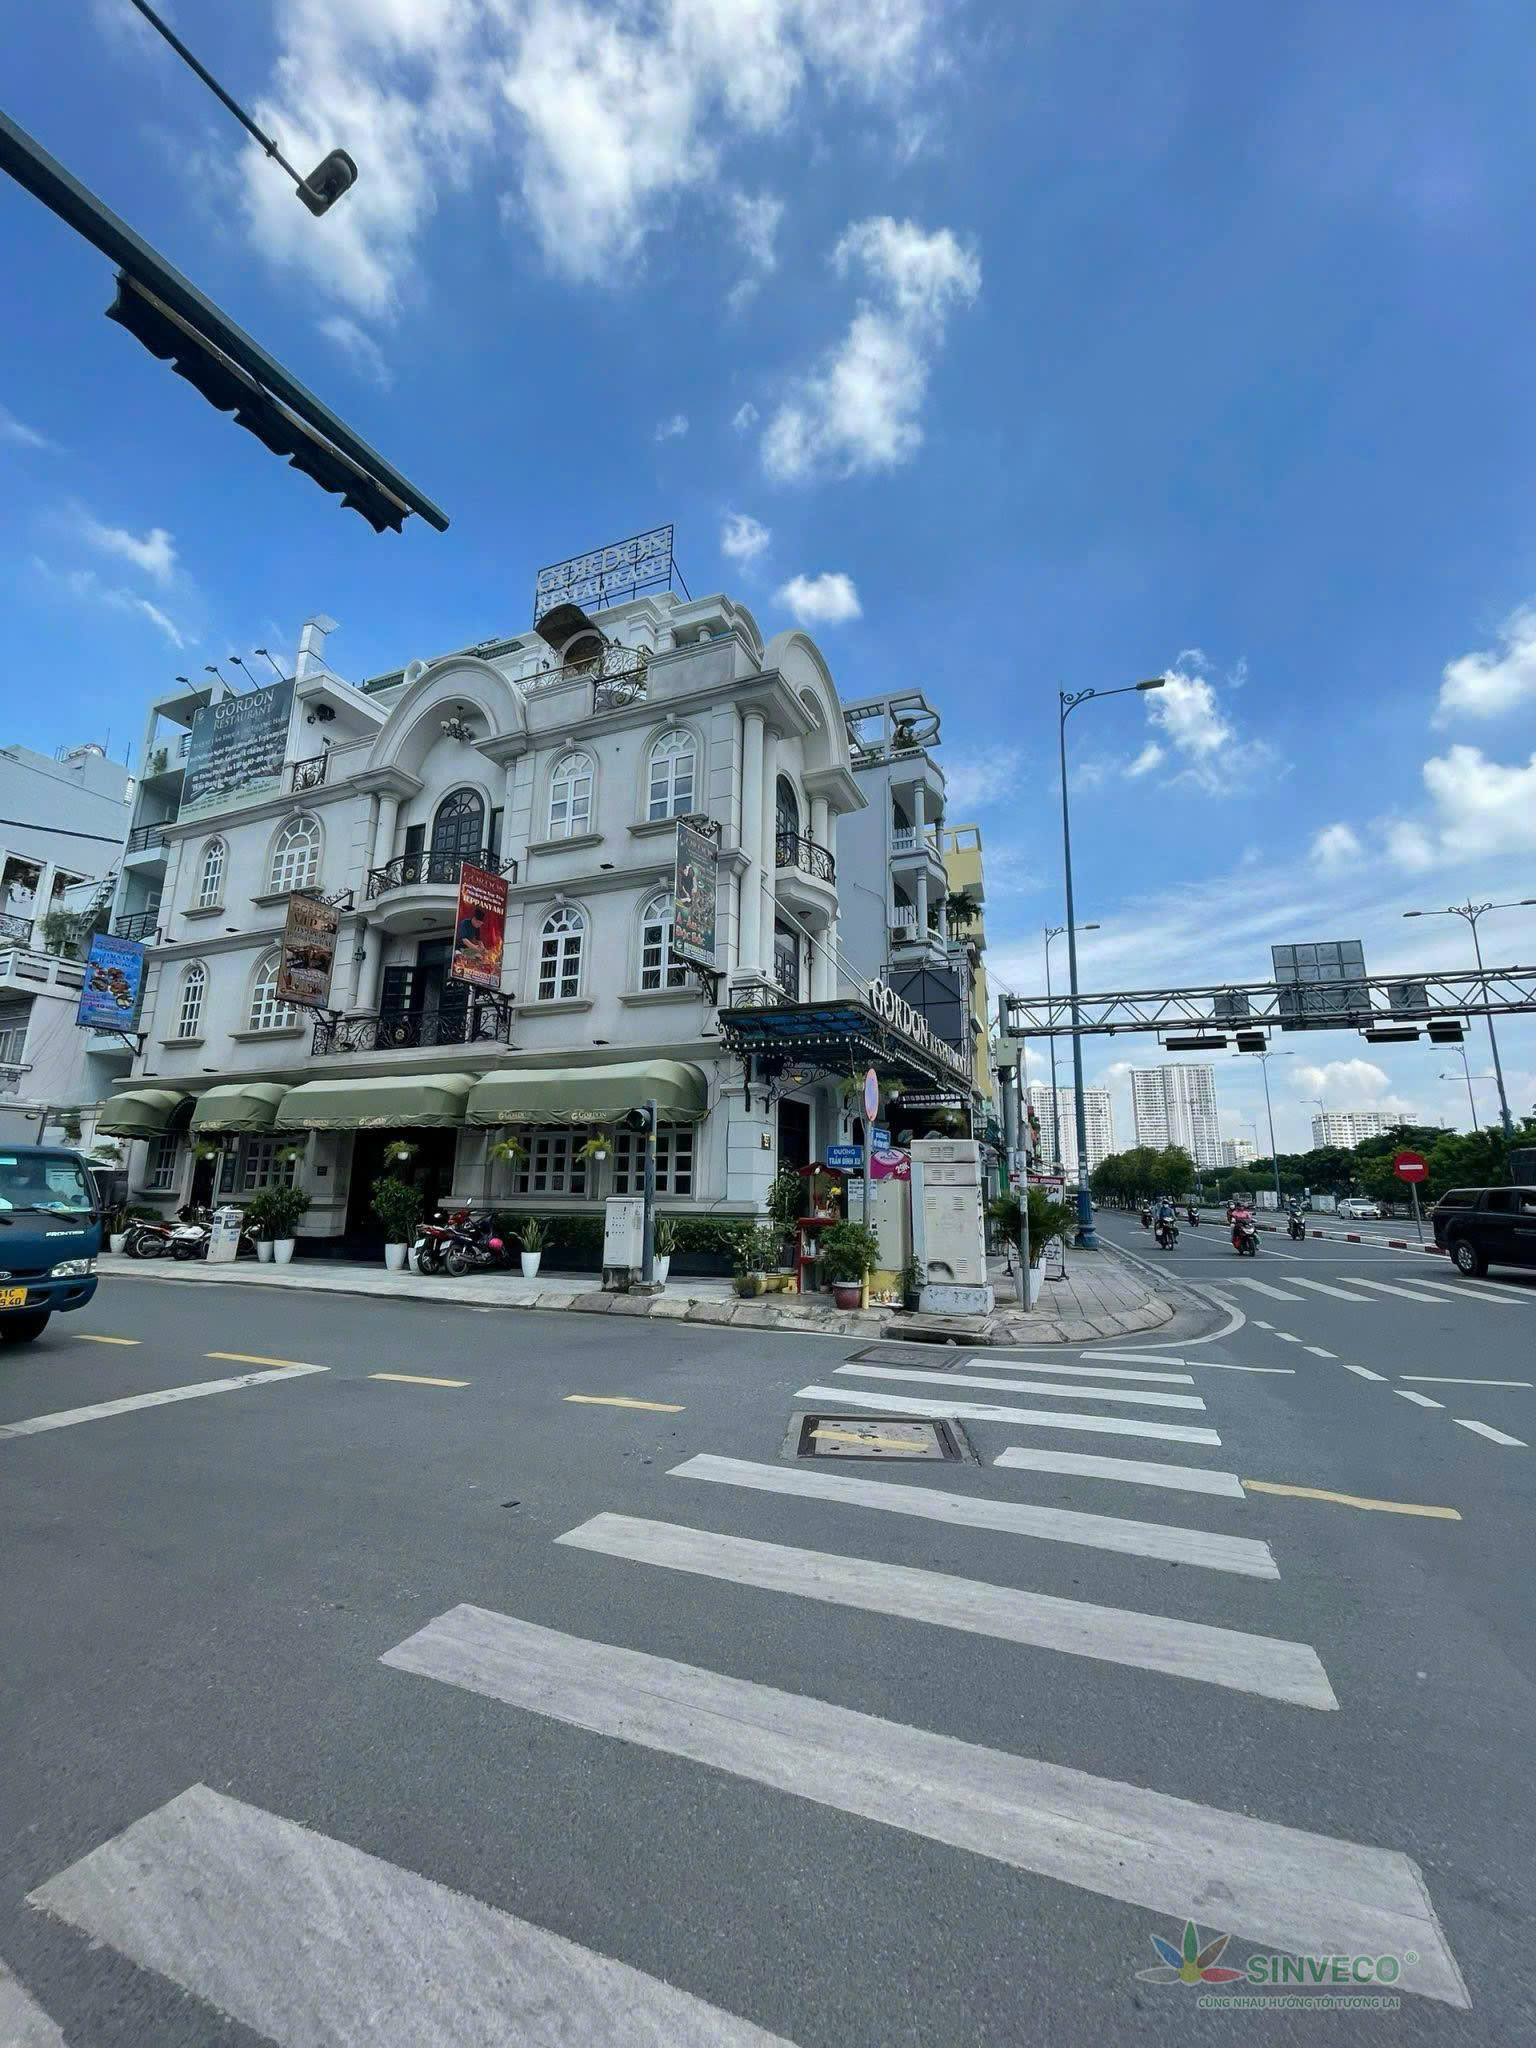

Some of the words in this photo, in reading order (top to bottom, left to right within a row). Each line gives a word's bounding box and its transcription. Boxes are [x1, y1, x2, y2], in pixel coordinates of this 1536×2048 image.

[538, 529, 669, 593] GORDON
[537, 556, 671, 614] RESTAURANT
[213, 703, 272, 731] RESTAURANT
[215, 688, 274, 719] GORDON
[463, 894, 504, 915] TEPPANYAKI
[294, 912, 318, 930] VIP
[872, 977, 928, 1048] GORDON
[833, 1147, 856, 1156] ĐƯỜNG
